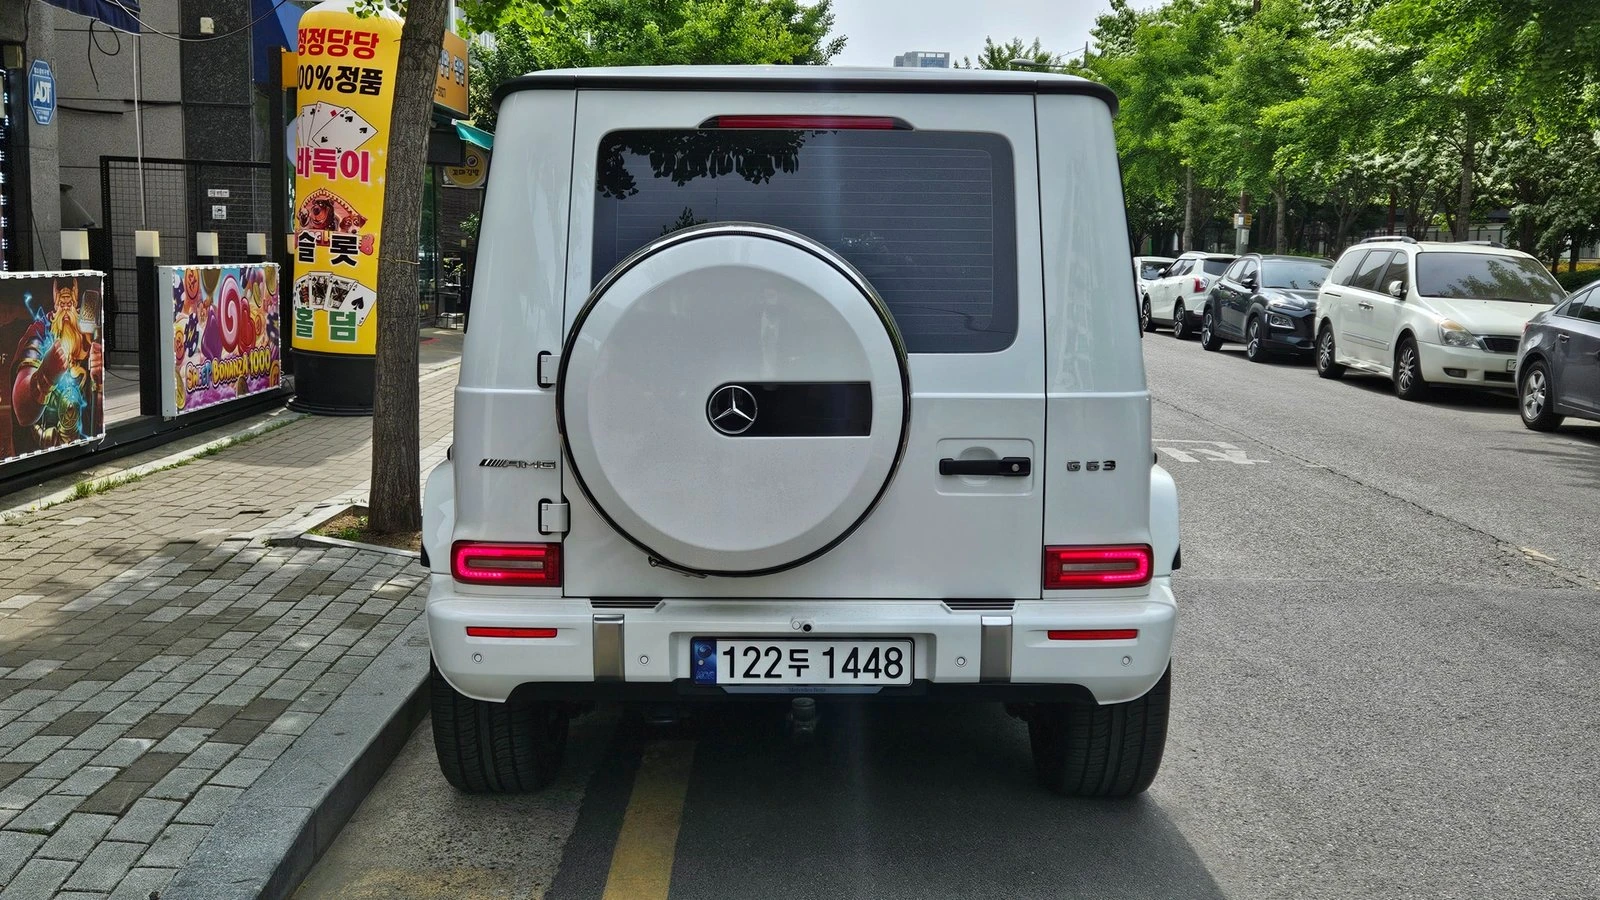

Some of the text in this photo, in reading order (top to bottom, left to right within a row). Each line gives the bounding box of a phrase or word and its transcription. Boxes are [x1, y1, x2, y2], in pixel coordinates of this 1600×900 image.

[34, 81, 51, 103] ADT
[297, 64, 383, 96] 00%정품
[297, 147, 369, 182] 바둑이
[249, 346, 272, 376] 1000
[723, 646, 904, 679] 122두 1448
